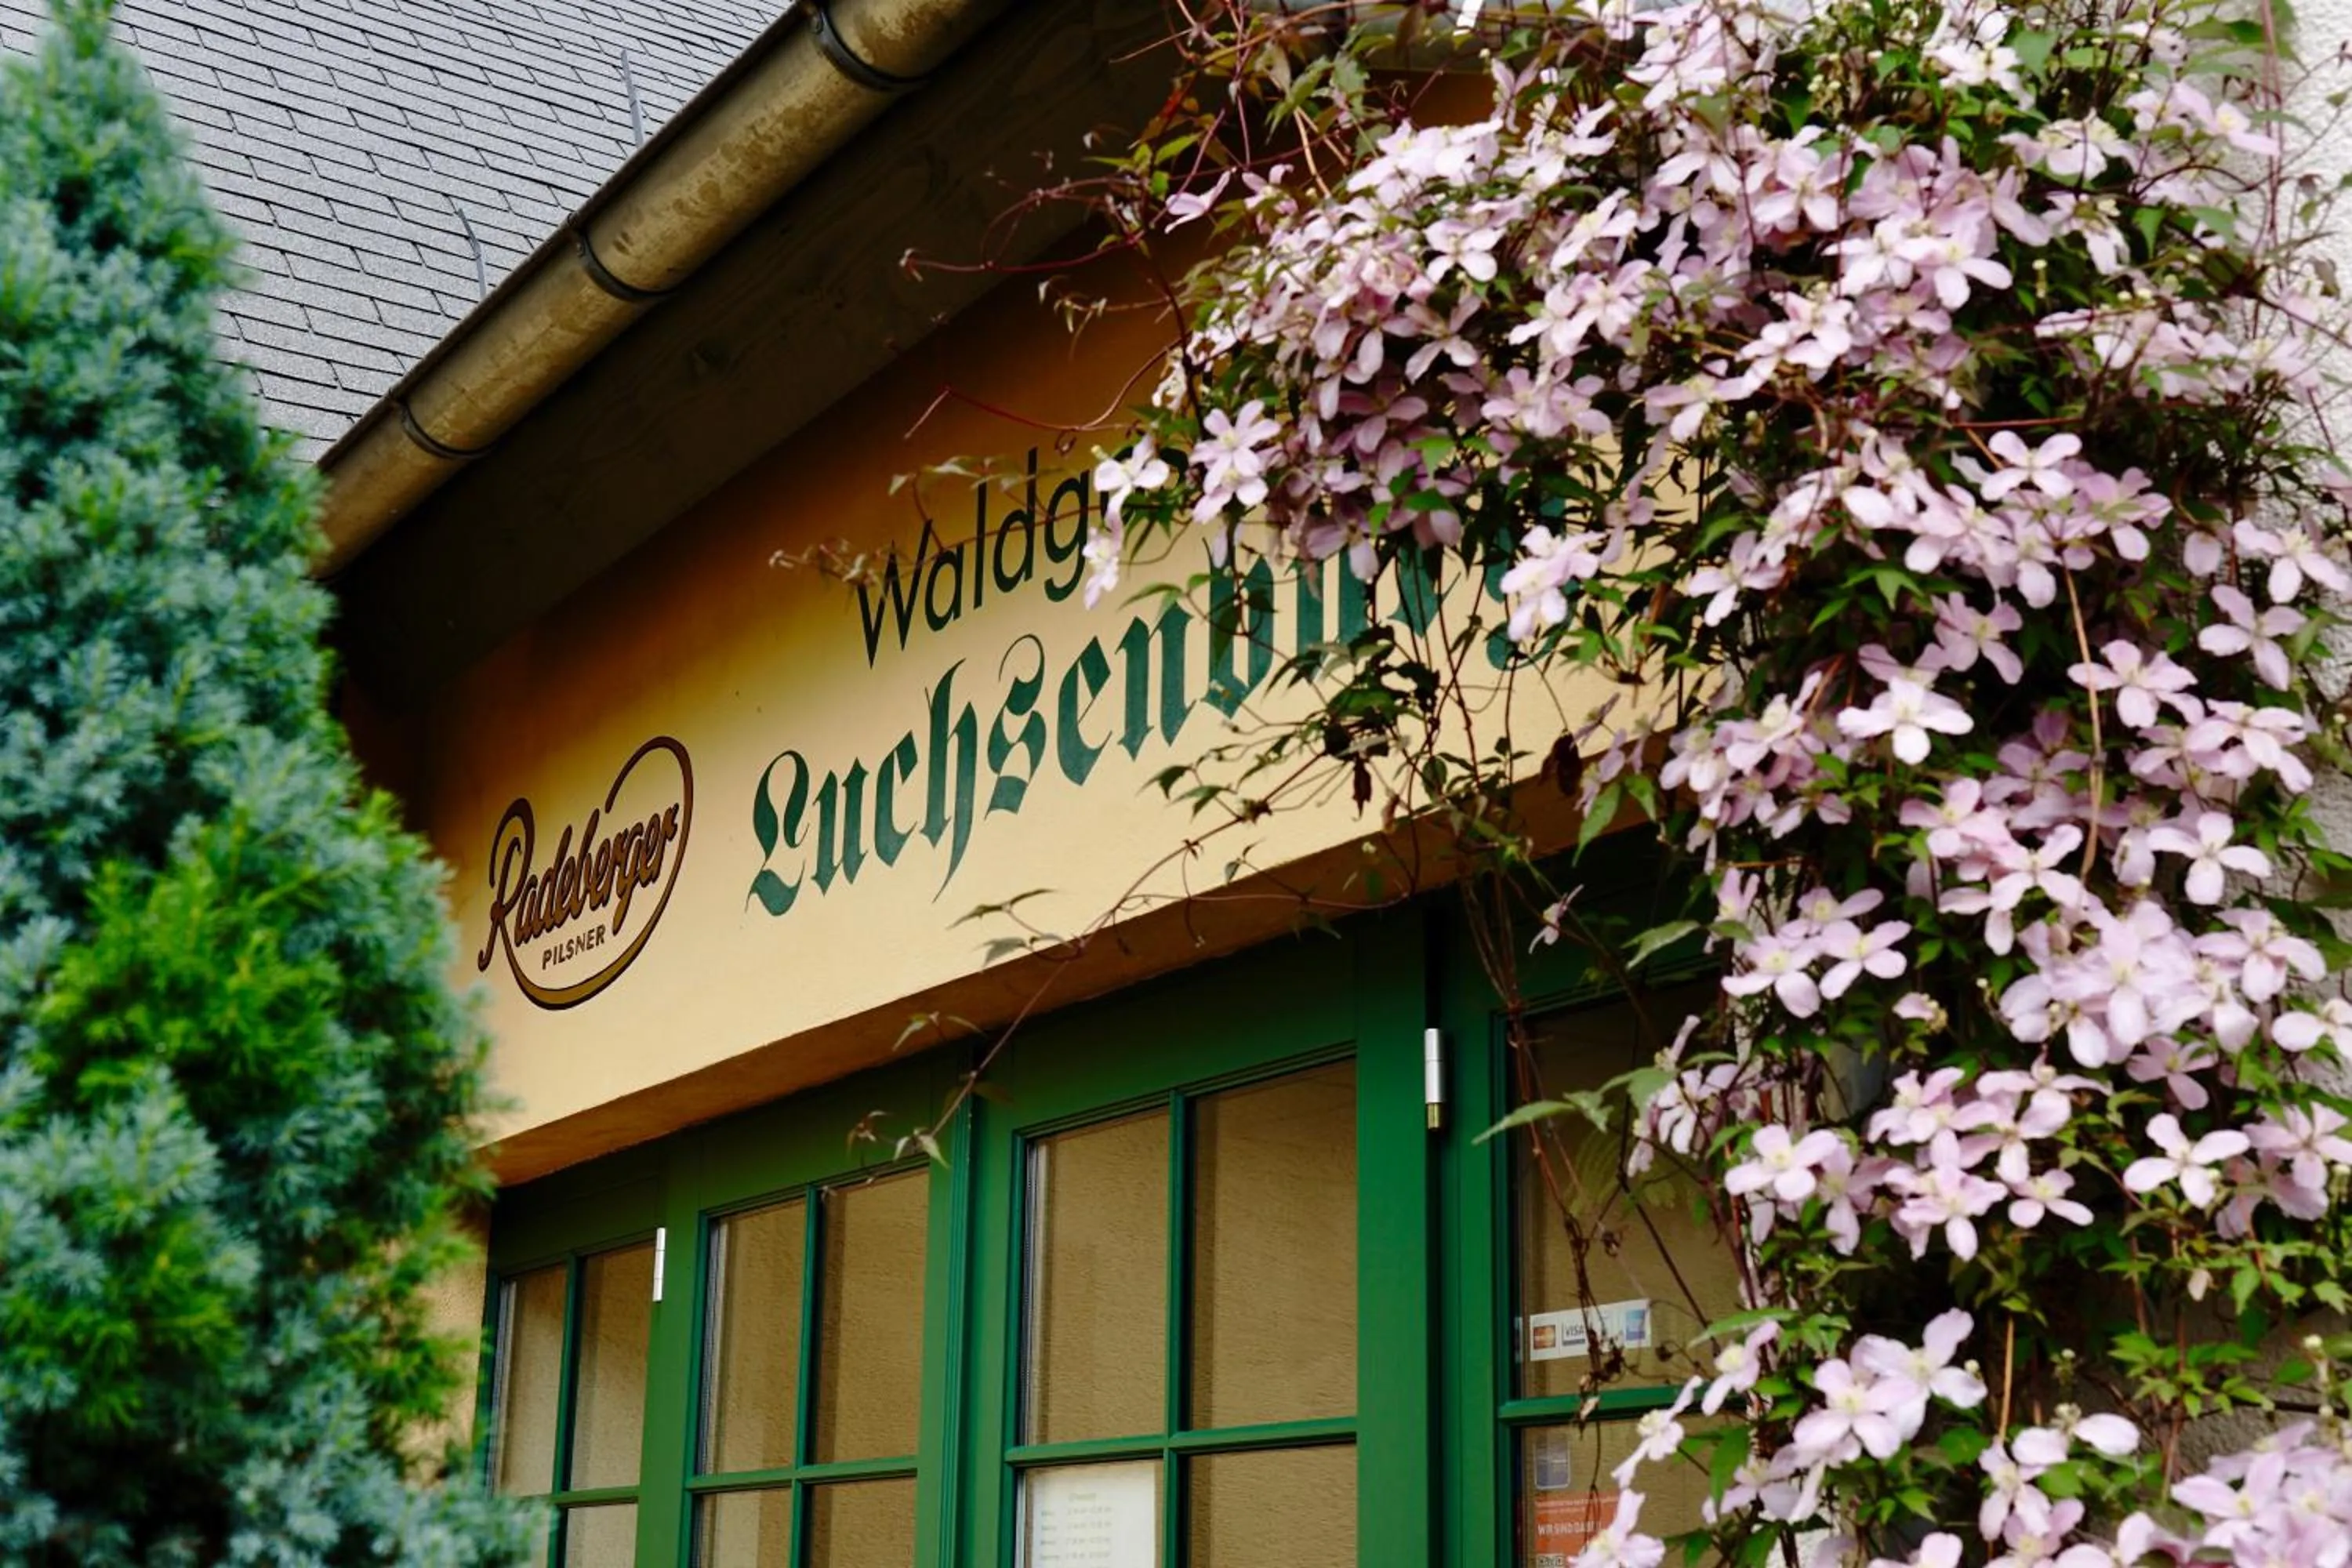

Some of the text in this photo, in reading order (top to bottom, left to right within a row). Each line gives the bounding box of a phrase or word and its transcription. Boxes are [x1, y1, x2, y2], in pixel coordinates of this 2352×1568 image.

[478, 797, 681, 971] Radeberger
[542, 924, 605, 971] PILSNER
[1566, 1322, 1584, 1337] VISA
